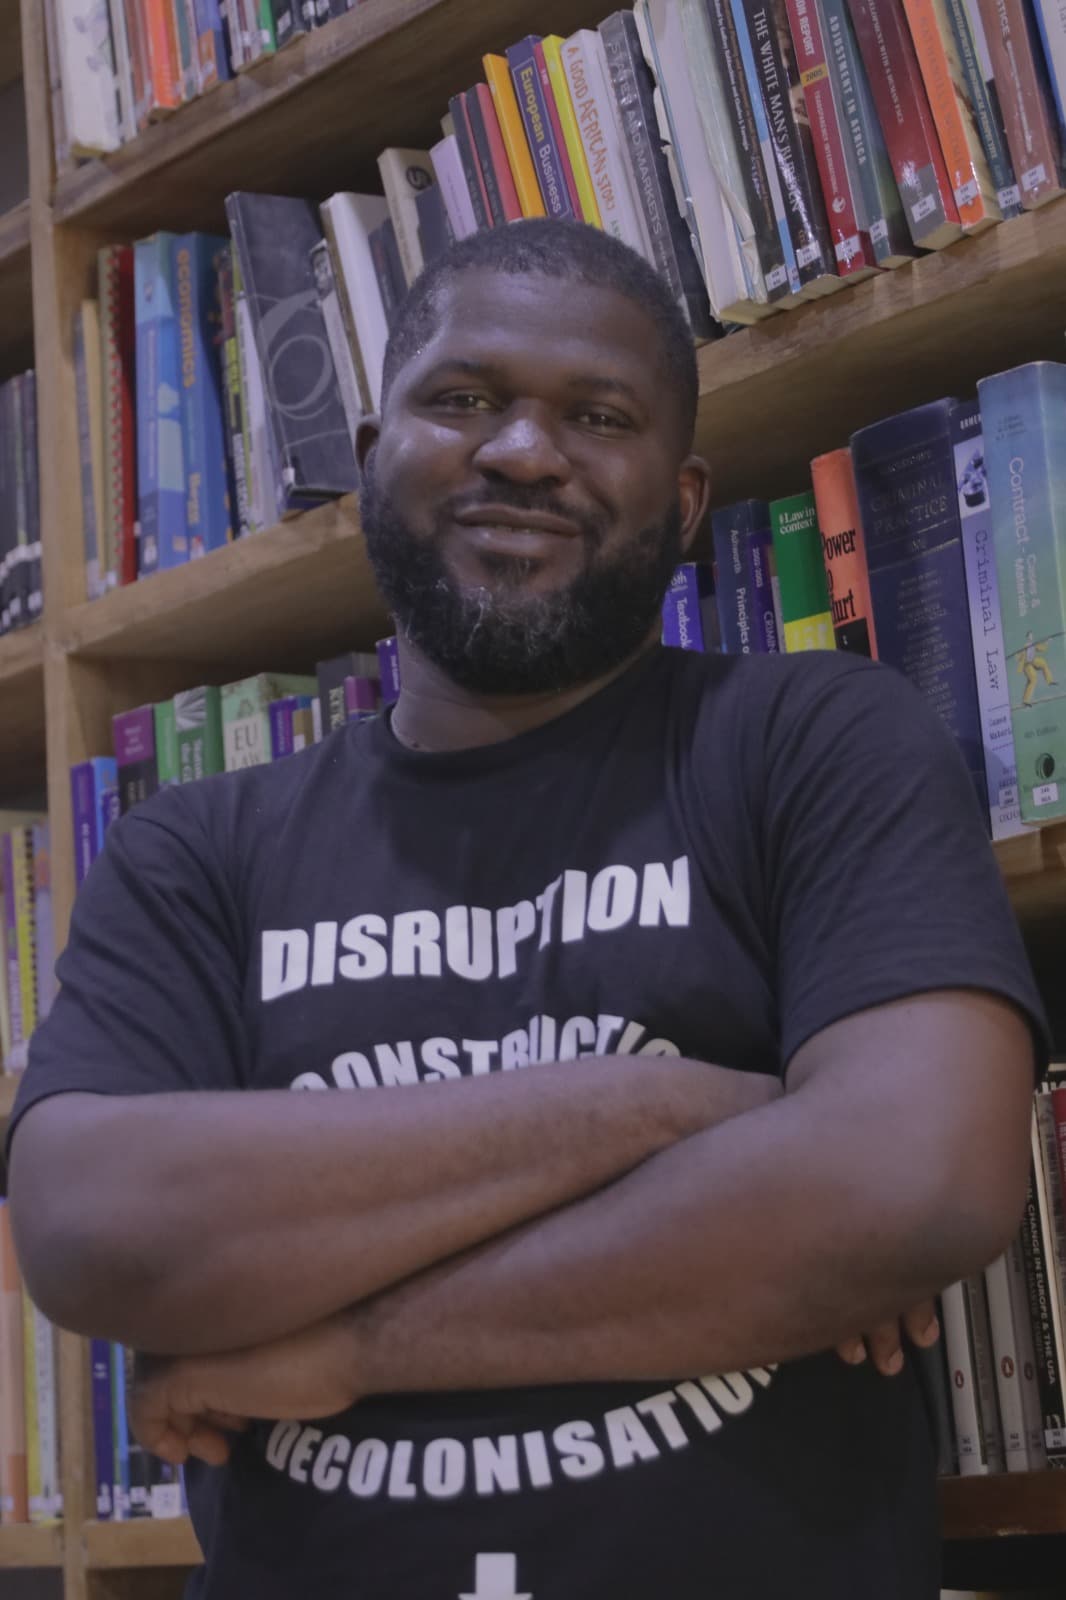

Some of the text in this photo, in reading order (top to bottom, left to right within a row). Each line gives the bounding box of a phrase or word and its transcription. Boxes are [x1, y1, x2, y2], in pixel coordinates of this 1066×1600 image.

[753, 8, 769, 40] THE
[800, 16, 815, 56] REPORT
[759, 40, 779, 92] WHITE
[829, 15, 867, 166] ADJUSTMENT IN AFRICA
[519, 66, 562, 214] European Business
[567, 46, 615, 212] A GOOD AFRICAN STORY
[606, 42, 663, 235] STATES AND MARKETS
[769, 93, 789, 145] MAN'S
[176, 248, 196, 389] economics
[779, 518, 814, 535] context
[782, 505, 815, 523] Law in
[1008, 456, 1031, 545] Contract
[730, 529, 742, 574] Ashworth
[736, 587, 750, 644] Principles
[975, 529, 1000, 690] Criminal Law
[676, 597, 693, 649] Textbook
[233, 727, 259, 751] EU
[260, 854, 691, 1003] DISRUPTION
[1028, 1203, 1042, 1255] CHANGE
[1034, 1256, 1042, 1272] IN
[1036, 1272, 1049, 1319] EUROPE
[1042, 1333, 1054, 1357] THE
[1046, 1359, 1056, 1385] USA
